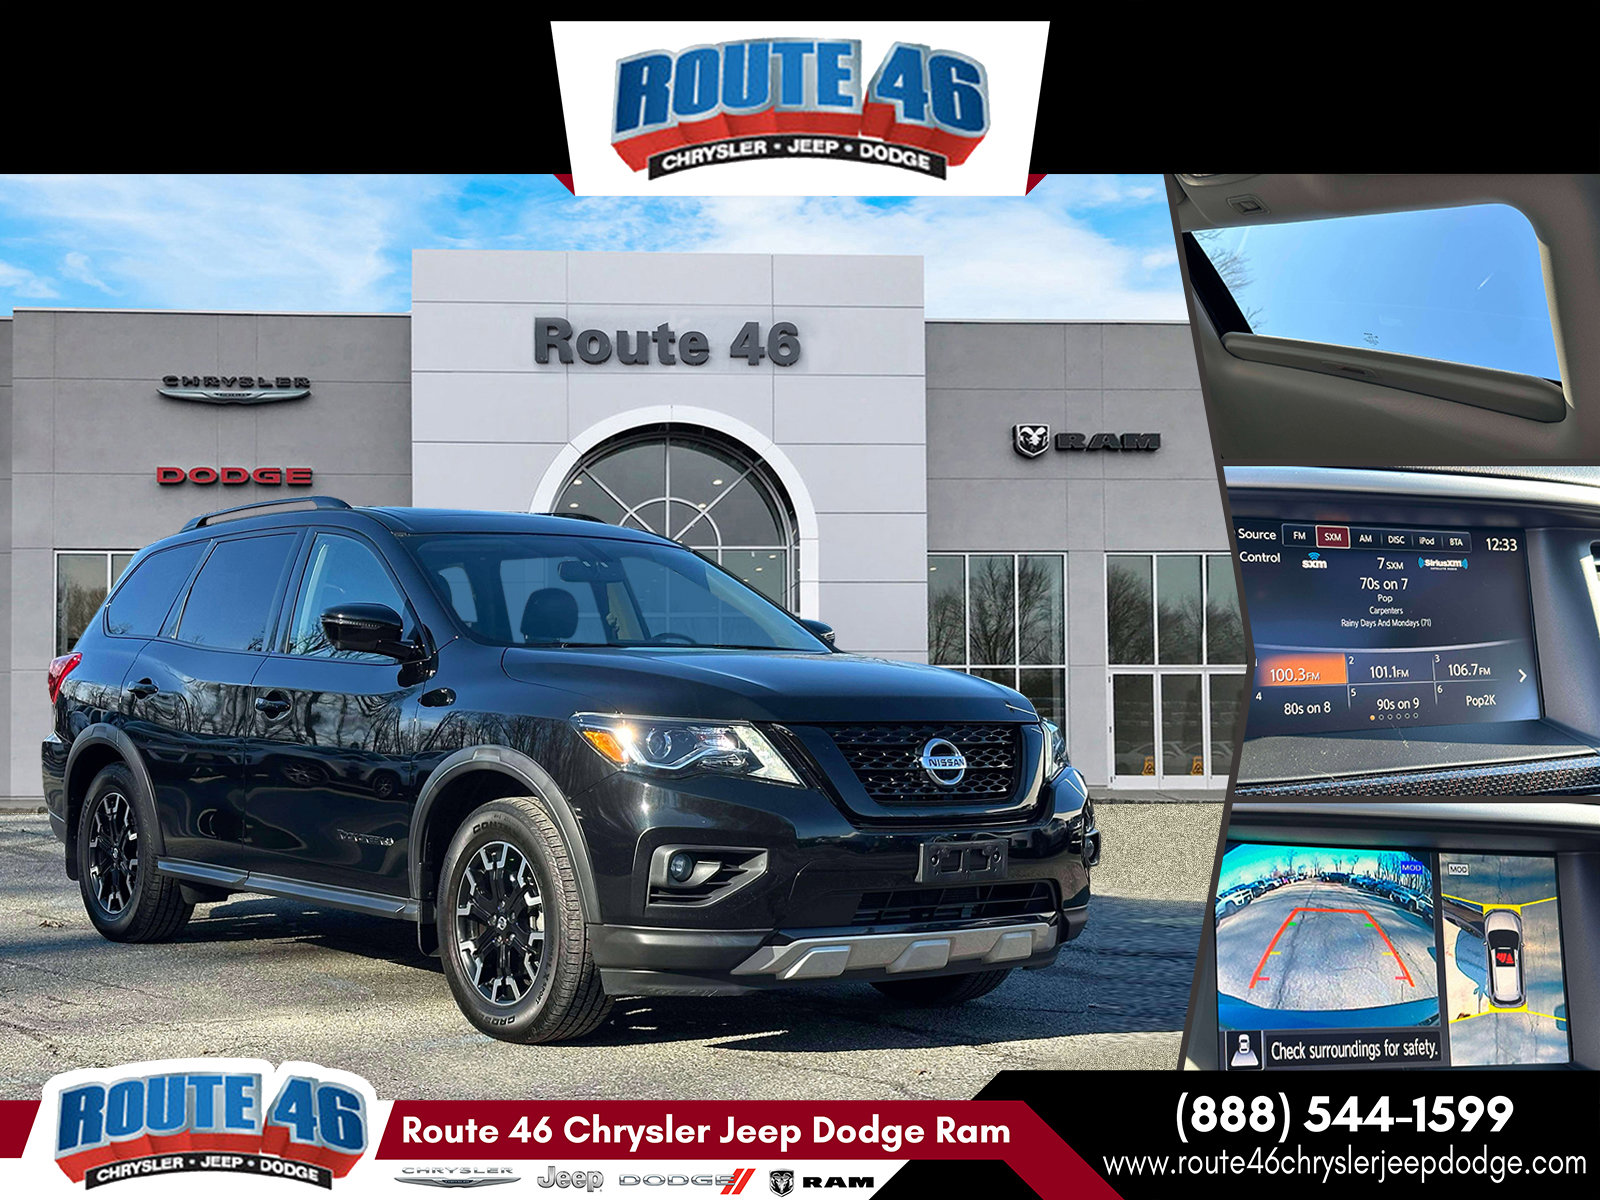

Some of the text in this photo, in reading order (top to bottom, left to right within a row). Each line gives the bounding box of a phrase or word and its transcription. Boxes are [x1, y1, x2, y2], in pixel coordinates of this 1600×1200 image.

[534, 317, 802, 367] Route 46
[161, 375, 311, 388] CHRYSLER
[1054, 432, 1161, 452] RAM
[156, 466, 313, 486] DODGE
[1238, 527, 1277, 541] Source
[1293, 531, 1464, 547] FM SXM AM DISC iPod BTA
[1486, 537, 1518, 552] 12:33
[1239, 551, 1281, 563] Control
[1301, 559, 1328, 569] sxm
[1359, 576, 1409, 591] 70s on 7
[1377, 593, 1394, 604] Pop
[1369, 606, 1404, 616] Carpenters
[1341, 618, 1360, 629] Rainy
[1360, 618, 1377, 629] Days
[1377, 618, 1391, 628] And
[1391, 618, 1420, 629] Mondays
[1348, 655, 1355, 665] 2
[1434, 653, 1441, 663] 3
[1350, 687, 1357, 697] 5
[1436, 684, 1443, 694] 6
[1255, 691, 1263, 701] 4
[1465, 694, 1497, 708] Pop2K
[1283, 700, 1332, 716] 80s on 8
[1376, 697, 1420, 711] 90s on 9
[929, 758, 964, 767] NISSAN
[1402, 864, 1421, 872] MOD
[1449, 866, 1467, 874] MOD
[1271, 1037, 1439, 1061] Check surroundings for safety.
